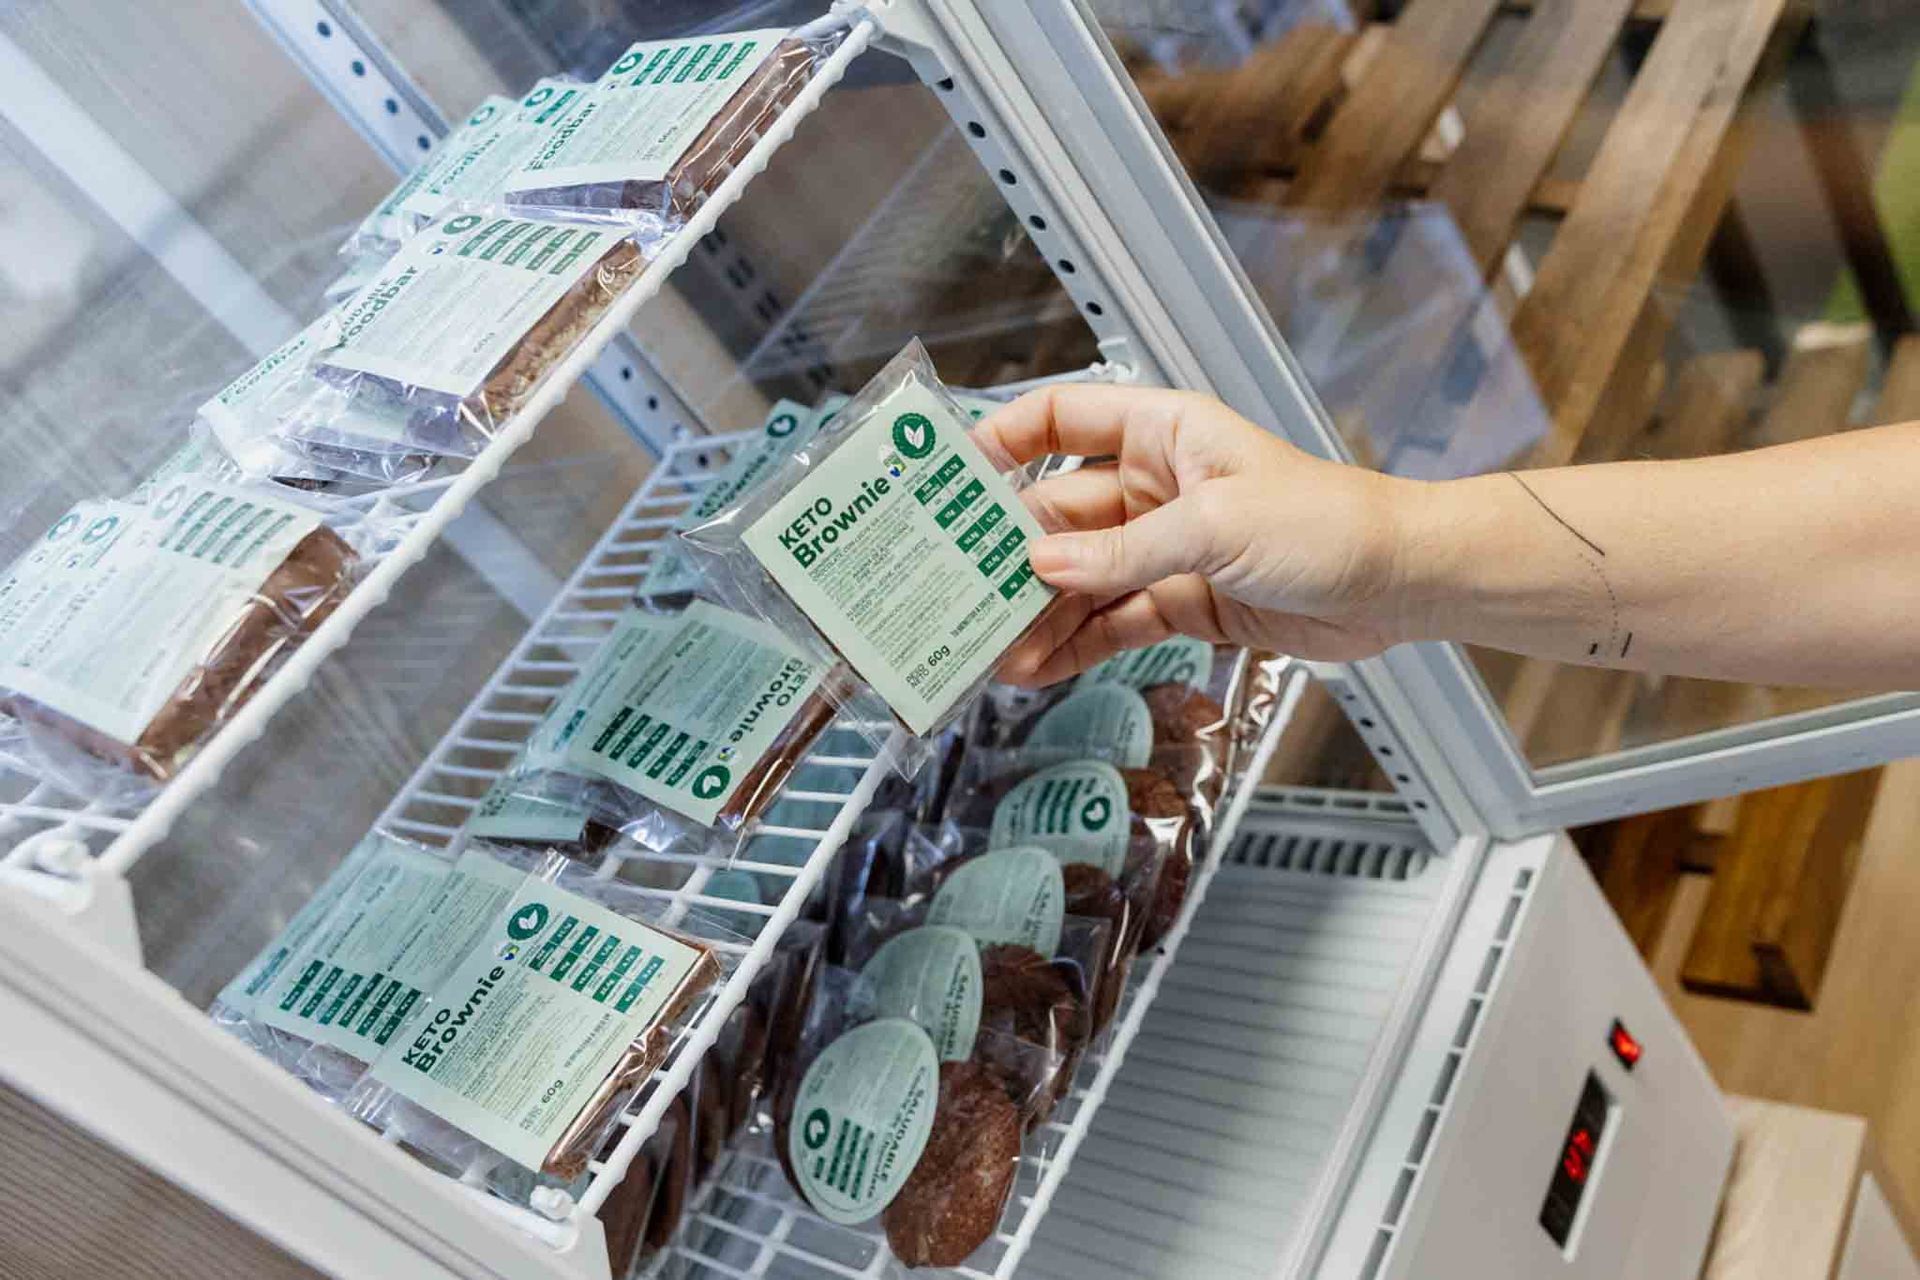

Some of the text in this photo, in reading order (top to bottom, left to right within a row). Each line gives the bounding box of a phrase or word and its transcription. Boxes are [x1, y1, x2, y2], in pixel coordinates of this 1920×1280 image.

[778, 497, 832, 549] KETO
[791, 476, 891, 568] Brownie
[926, 644, 951, 667] 60g
[728, 657, 803, 742] Brownie
[400, 1008, 450, 1065] KETO
[414, 965, 505, 1073] Brownie
[540, 1078, 564, 1104] 60g
